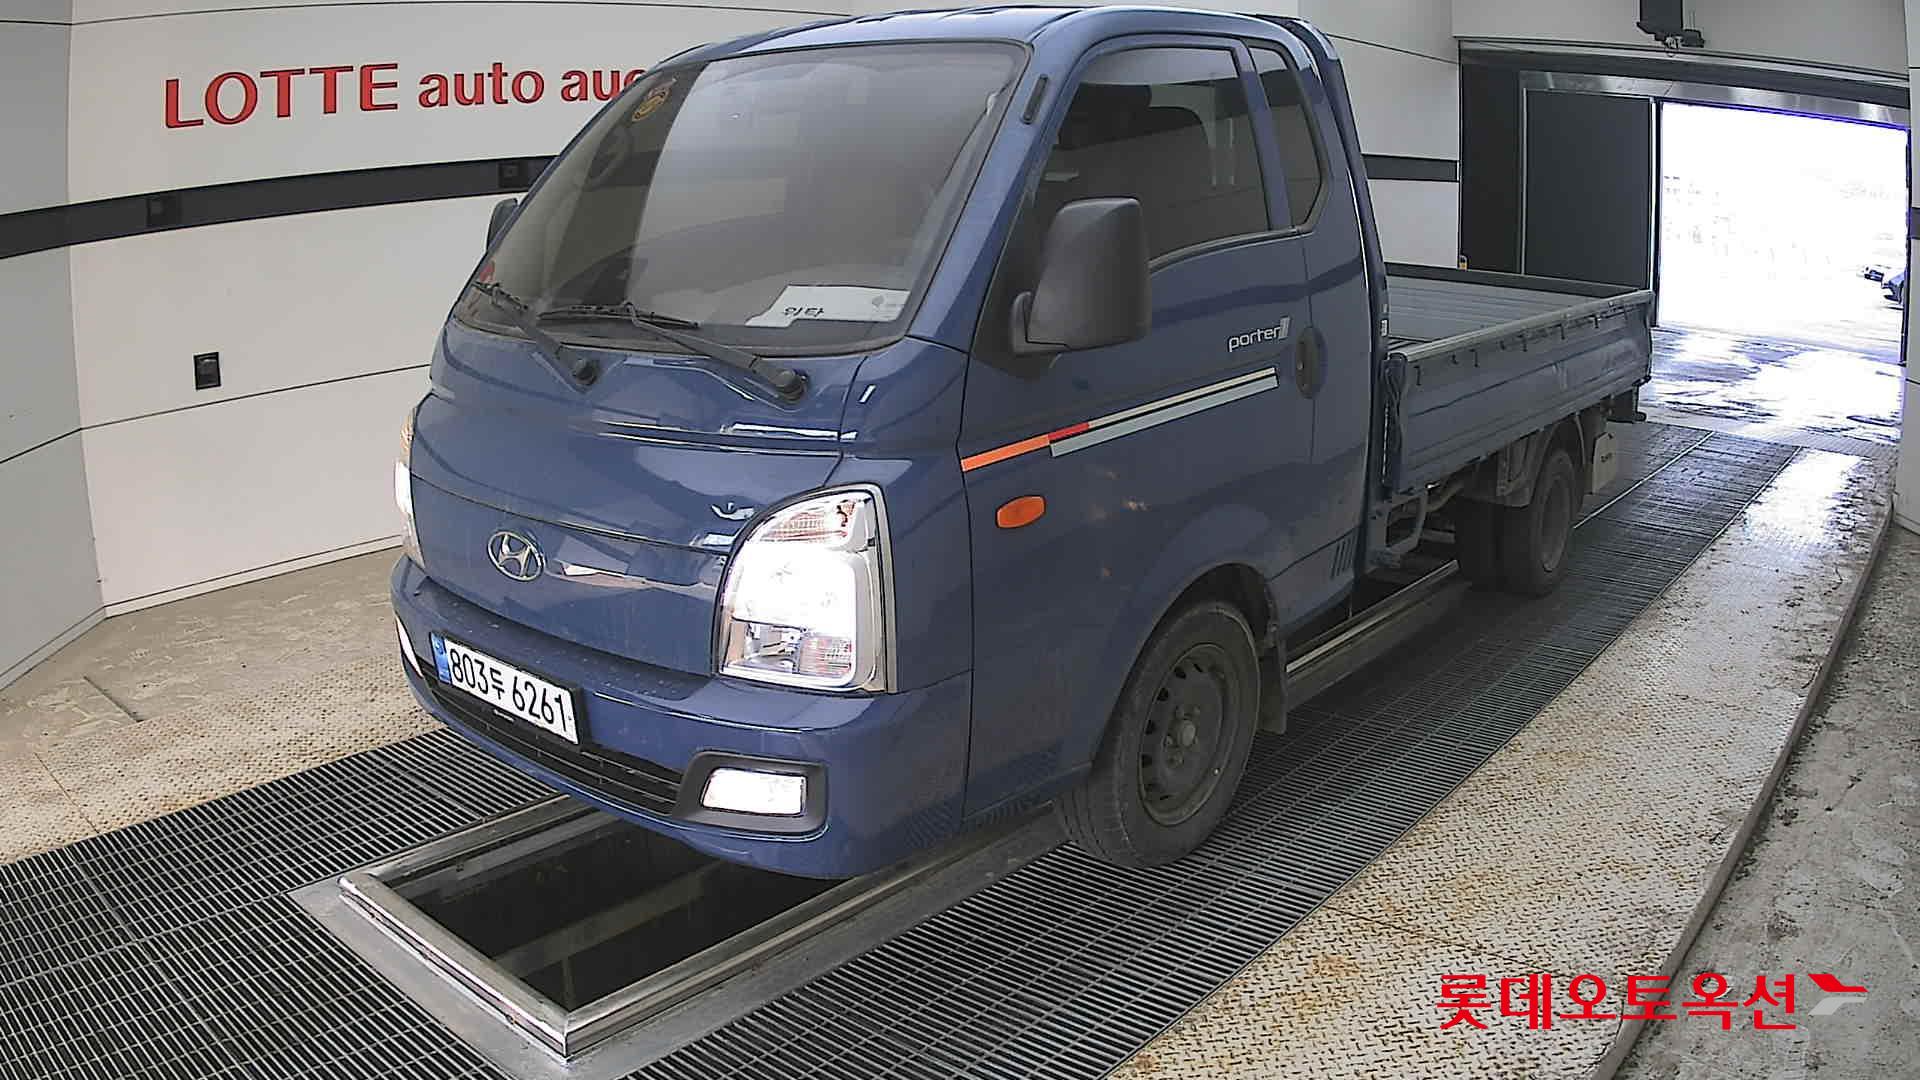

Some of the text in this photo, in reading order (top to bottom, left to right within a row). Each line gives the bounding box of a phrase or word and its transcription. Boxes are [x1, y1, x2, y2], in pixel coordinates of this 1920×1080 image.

[165, 63, 398, 128] LOTTE
[418, 62, 545, 108] auto
[1228, 326, 1280, 353] porter
[449, 648, 567, 732] 803두 6261
